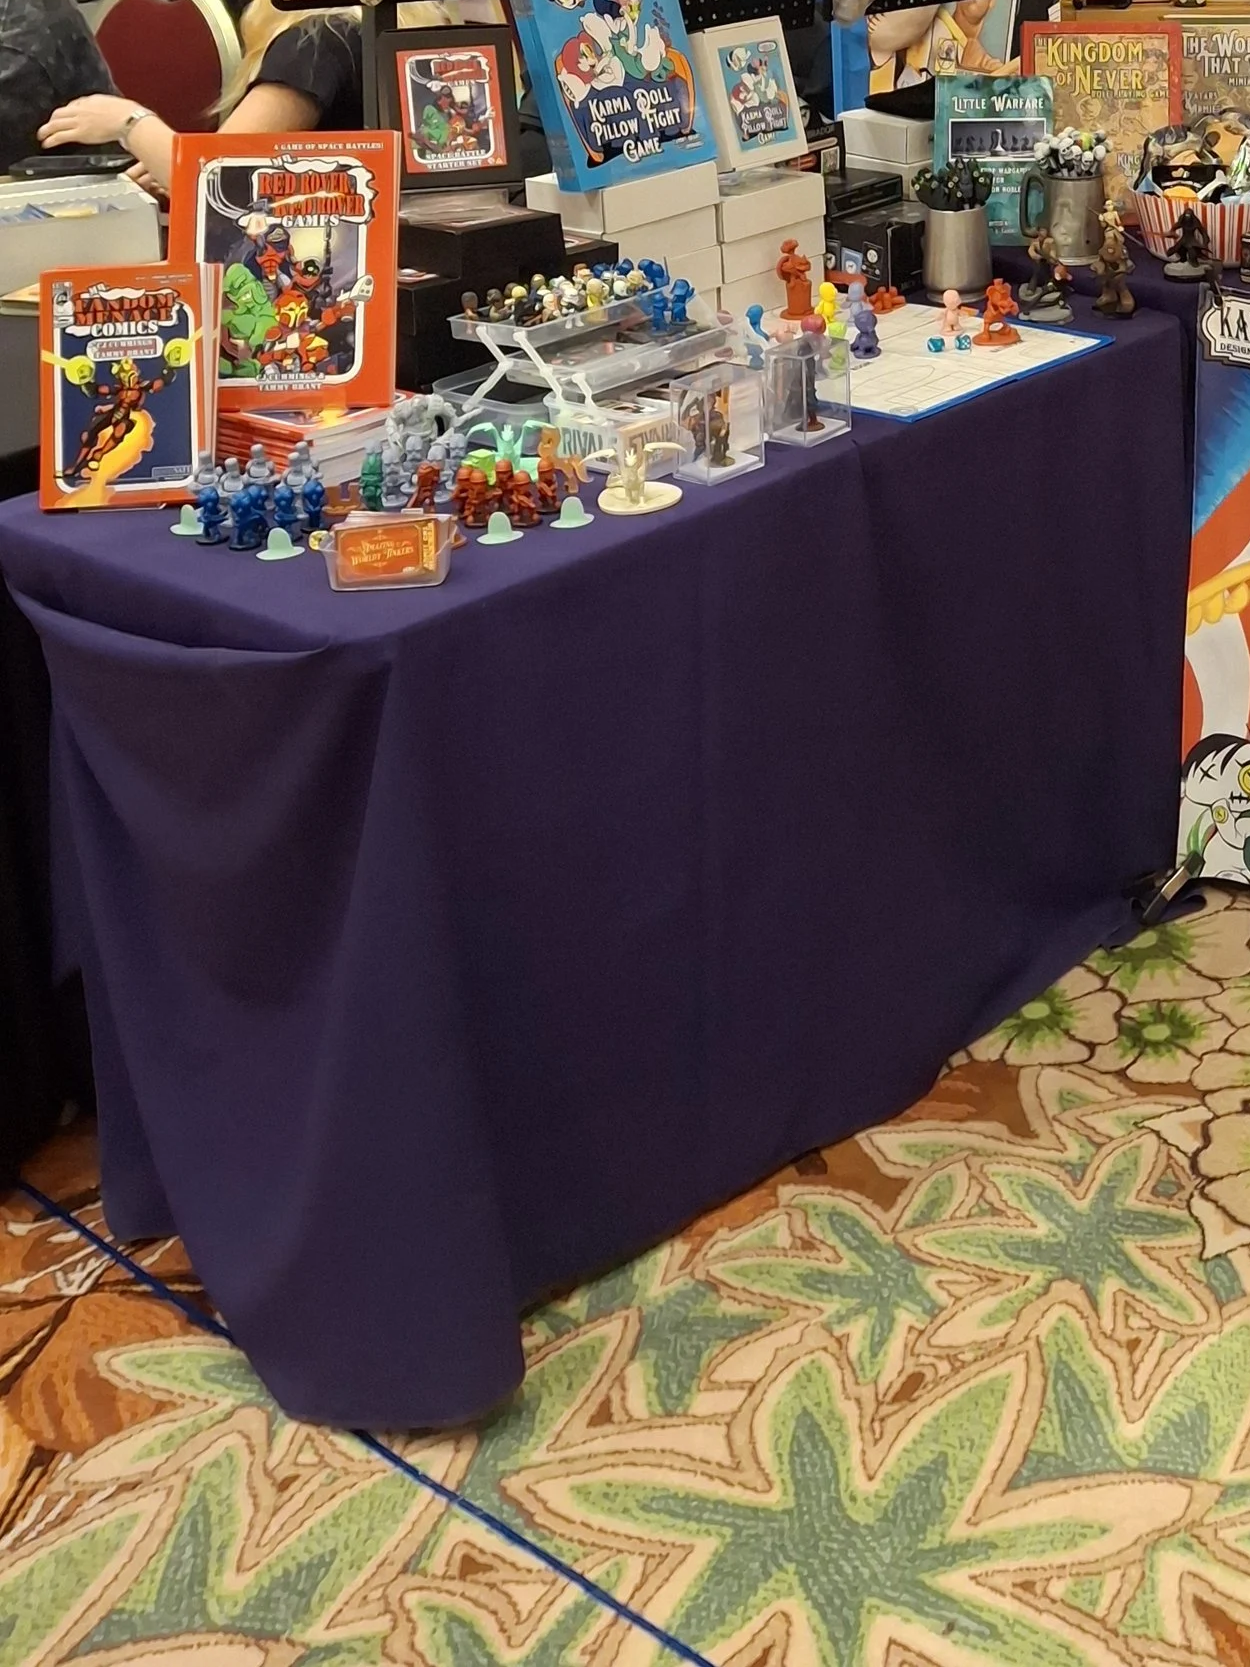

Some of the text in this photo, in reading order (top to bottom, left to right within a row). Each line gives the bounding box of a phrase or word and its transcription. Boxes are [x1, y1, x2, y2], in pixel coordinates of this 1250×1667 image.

[1047, 38, 1144, 69] KINGDOM
[1182, 32, 1208, 58] THE
[1197, 50, 1240, 79] THAT
[1057, 67, 1144, 96] OF NEVER
[589, 87, 673, 122] KARMA DOLL
[952, 94, 1044, 113] LITTLE WARFARE
[741, 106, 782, 124] KARMA DOLL
[590, 108, 681, 146] PILLOW FIGHT
[741, 117, 787, 135] PILLOW FIGHT
[317, 142, 344, 150] SPACE
[346, 142, 384, 150] BATTLES!
[623, 137, 663, 163] GAME
[259, 172, 297, 195] RED
[316, 194, 366, 216] ROVER
[282, 214, 340, 227] GAMES
[74, 294, 175, 312] FANDOM
[74, 308, 173, 325] MENACE
[91, 320, 159, 337] COMICS
[269, 372, 317, 382] CUMMINGS
[258, 383, 289, 392] TAMMY
